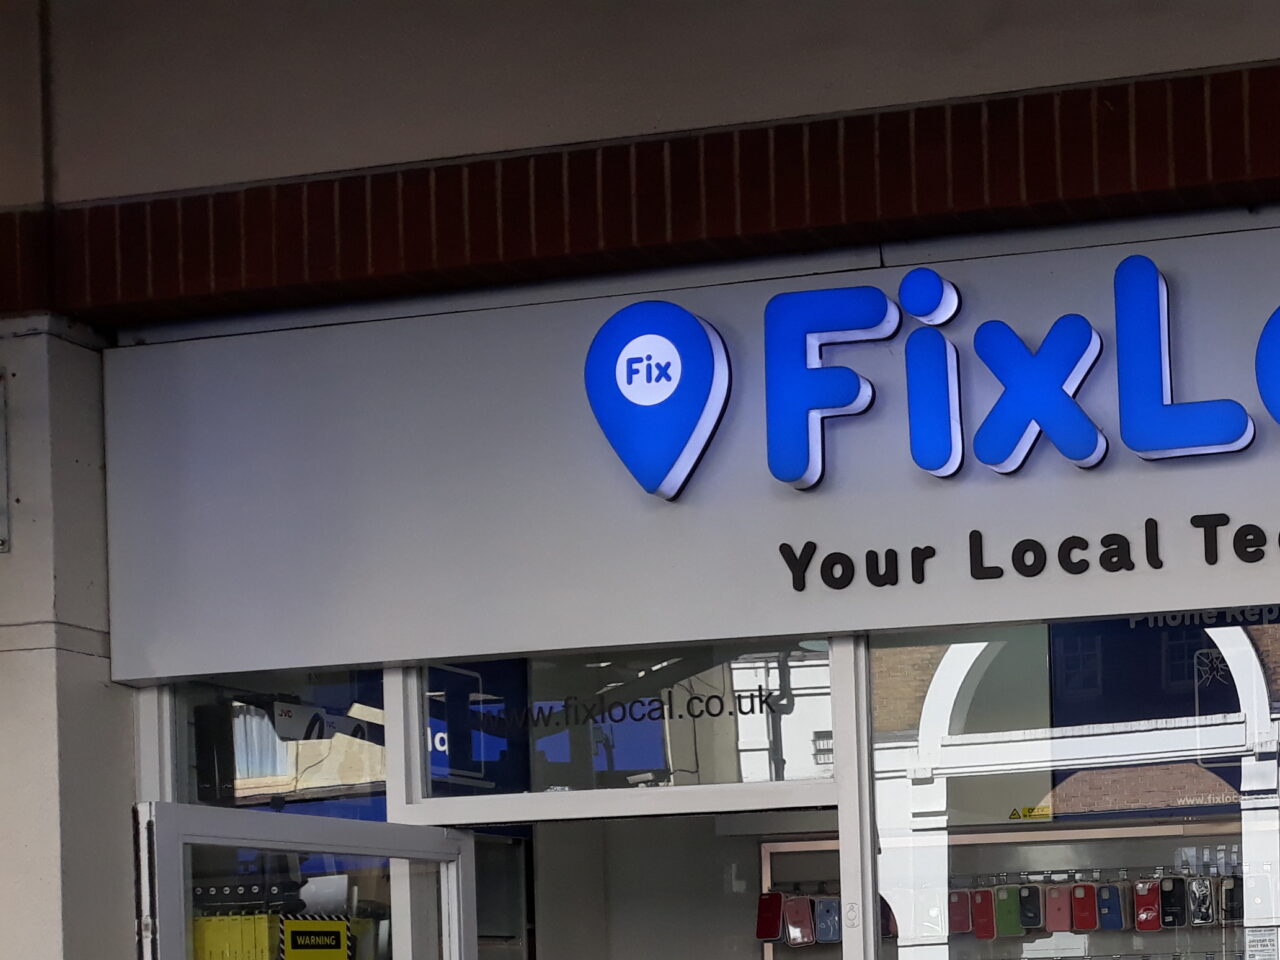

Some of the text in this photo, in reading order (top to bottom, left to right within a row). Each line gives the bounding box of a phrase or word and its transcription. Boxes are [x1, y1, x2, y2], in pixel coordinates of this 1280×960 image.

[625, 353, 672, 386] Fix
[778, 540, 936, 592] Your
[968, 517, 1164, 581] Local
[278, 709, 293, 718] JVC
[296, 935, 336, 946] WARNING
